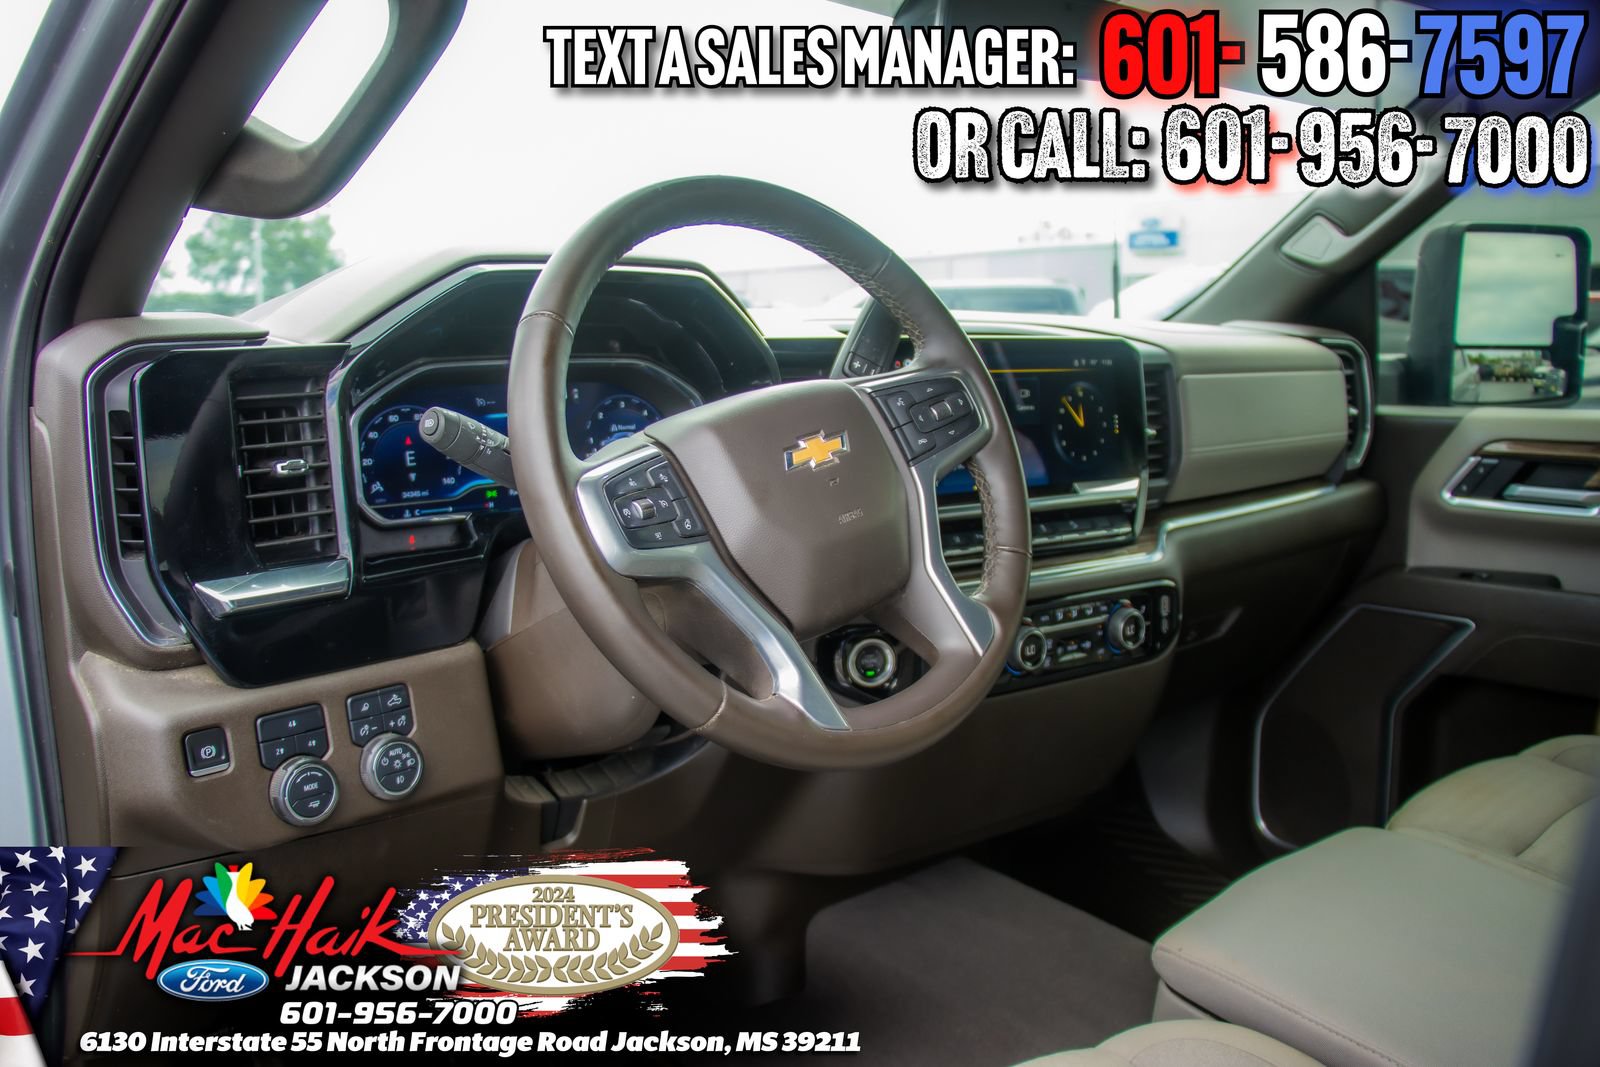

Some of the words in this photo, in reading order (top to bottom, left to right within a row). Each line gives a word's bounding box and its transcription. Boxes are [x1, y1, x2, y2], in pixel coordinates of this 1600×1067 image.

[368, 431, 379, 439] 40
[362, 458, 373, 466] 20
[405, 450, 416, 466] E
[388, 748, 403, 757] AUTO
[303, 782, 319, 792] MODE
